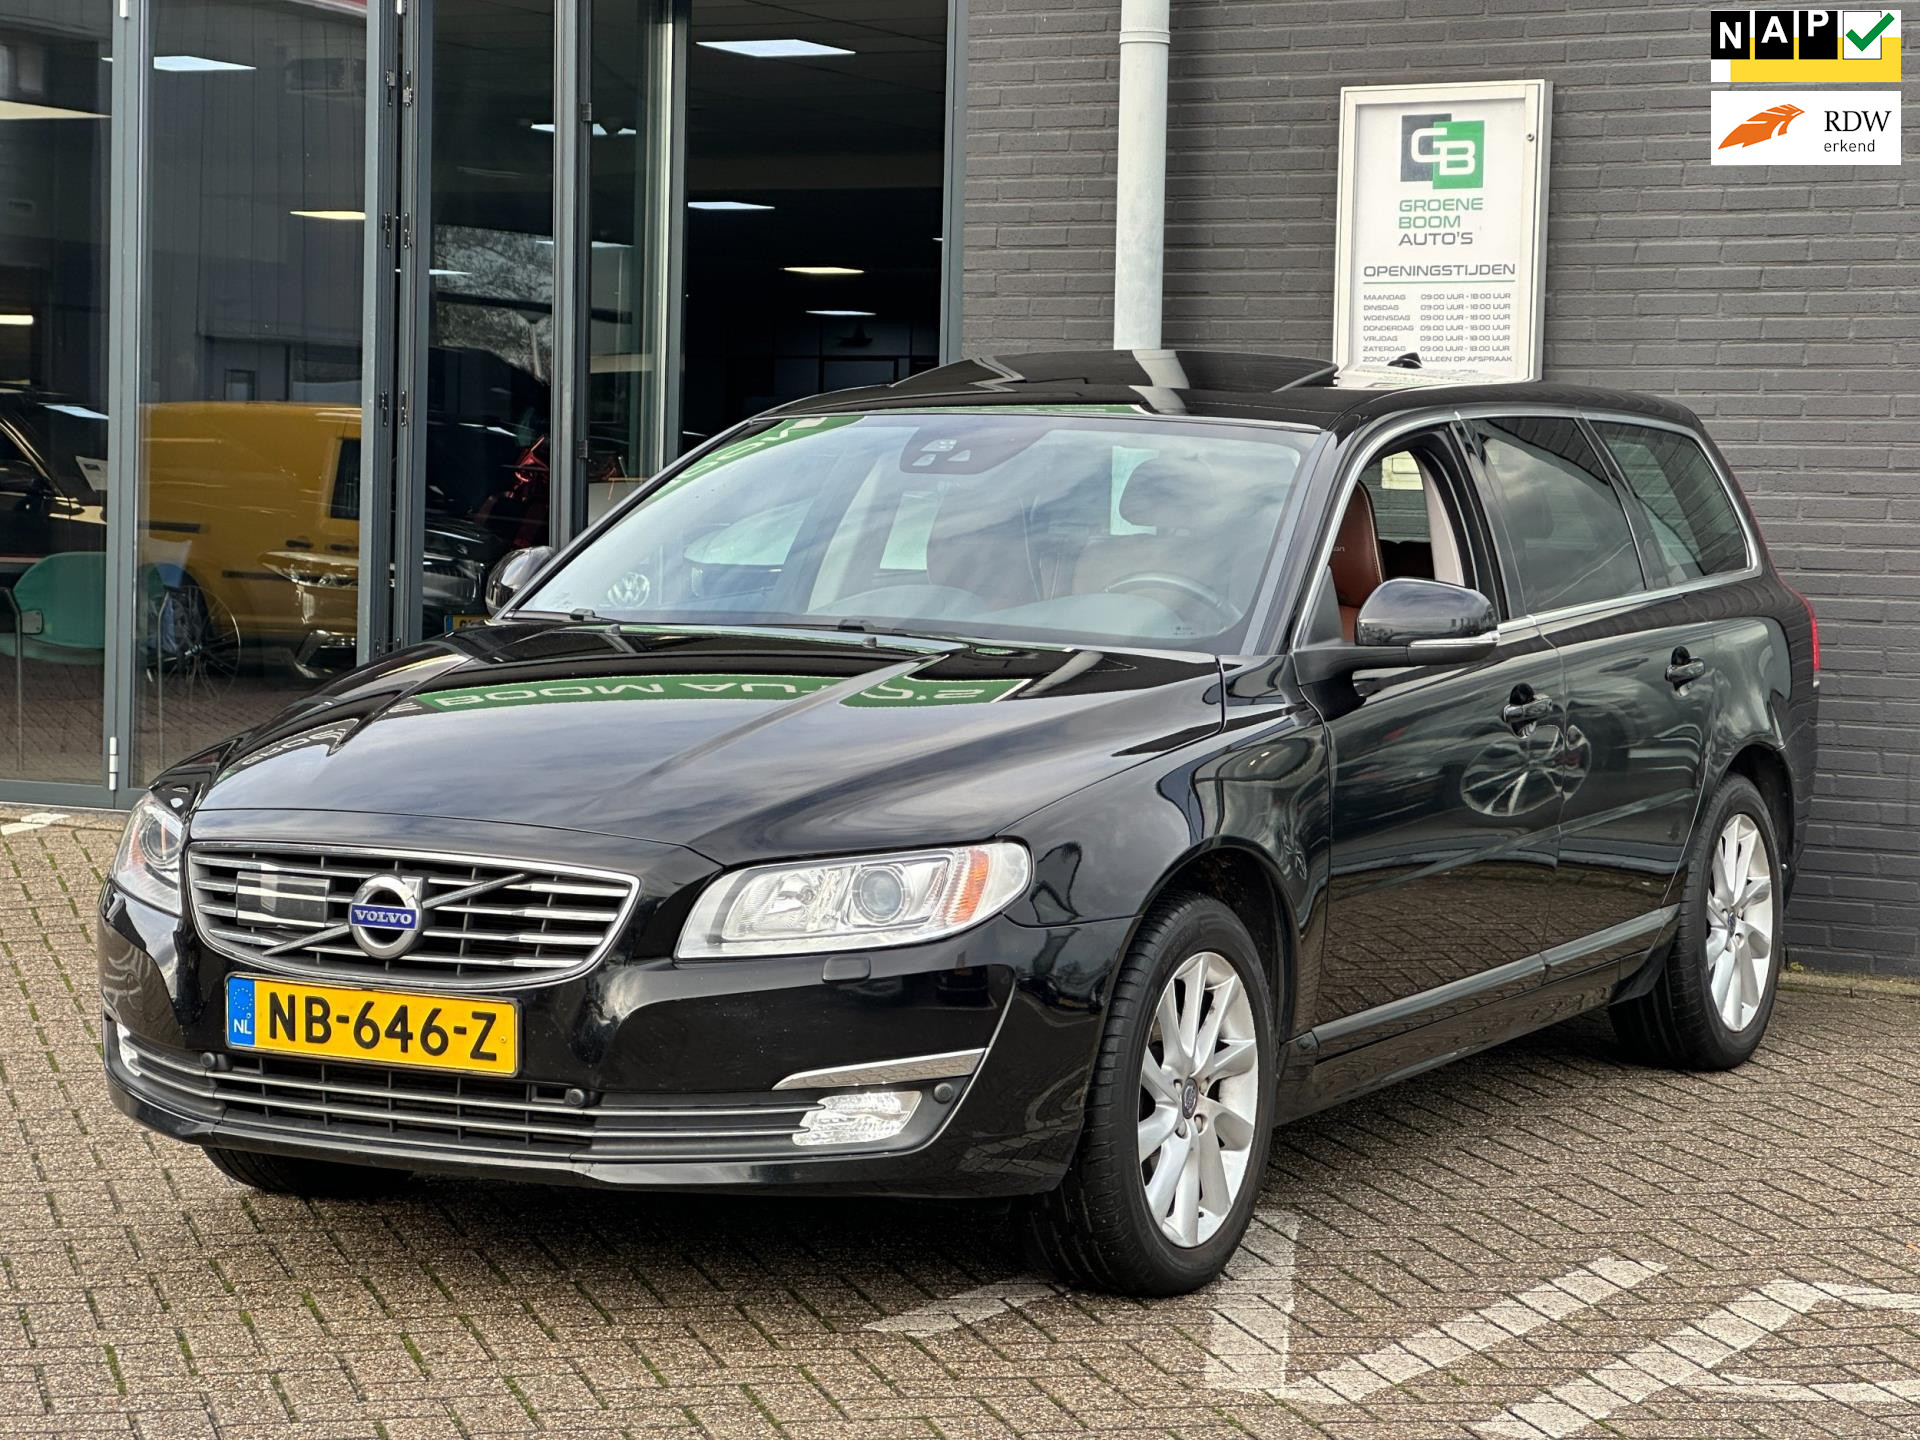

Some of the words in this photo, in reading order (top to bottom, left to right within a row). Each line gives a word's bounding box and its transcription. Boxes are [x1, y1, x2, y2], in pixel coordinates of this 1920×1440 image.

[1399, 197, 1484, 212] GROENE
[1398, 215, 1461, 229] BOOM
[1398, 231, 1473, 246] AUTO'S
[1363, 263, 1516, 277] OPENINGSTIJDEN
[354, 909, 412, 925] VOLVO
[233, 1018, 252, 1035] NL
[268, 991, 497, 1061] NB-646-Z
